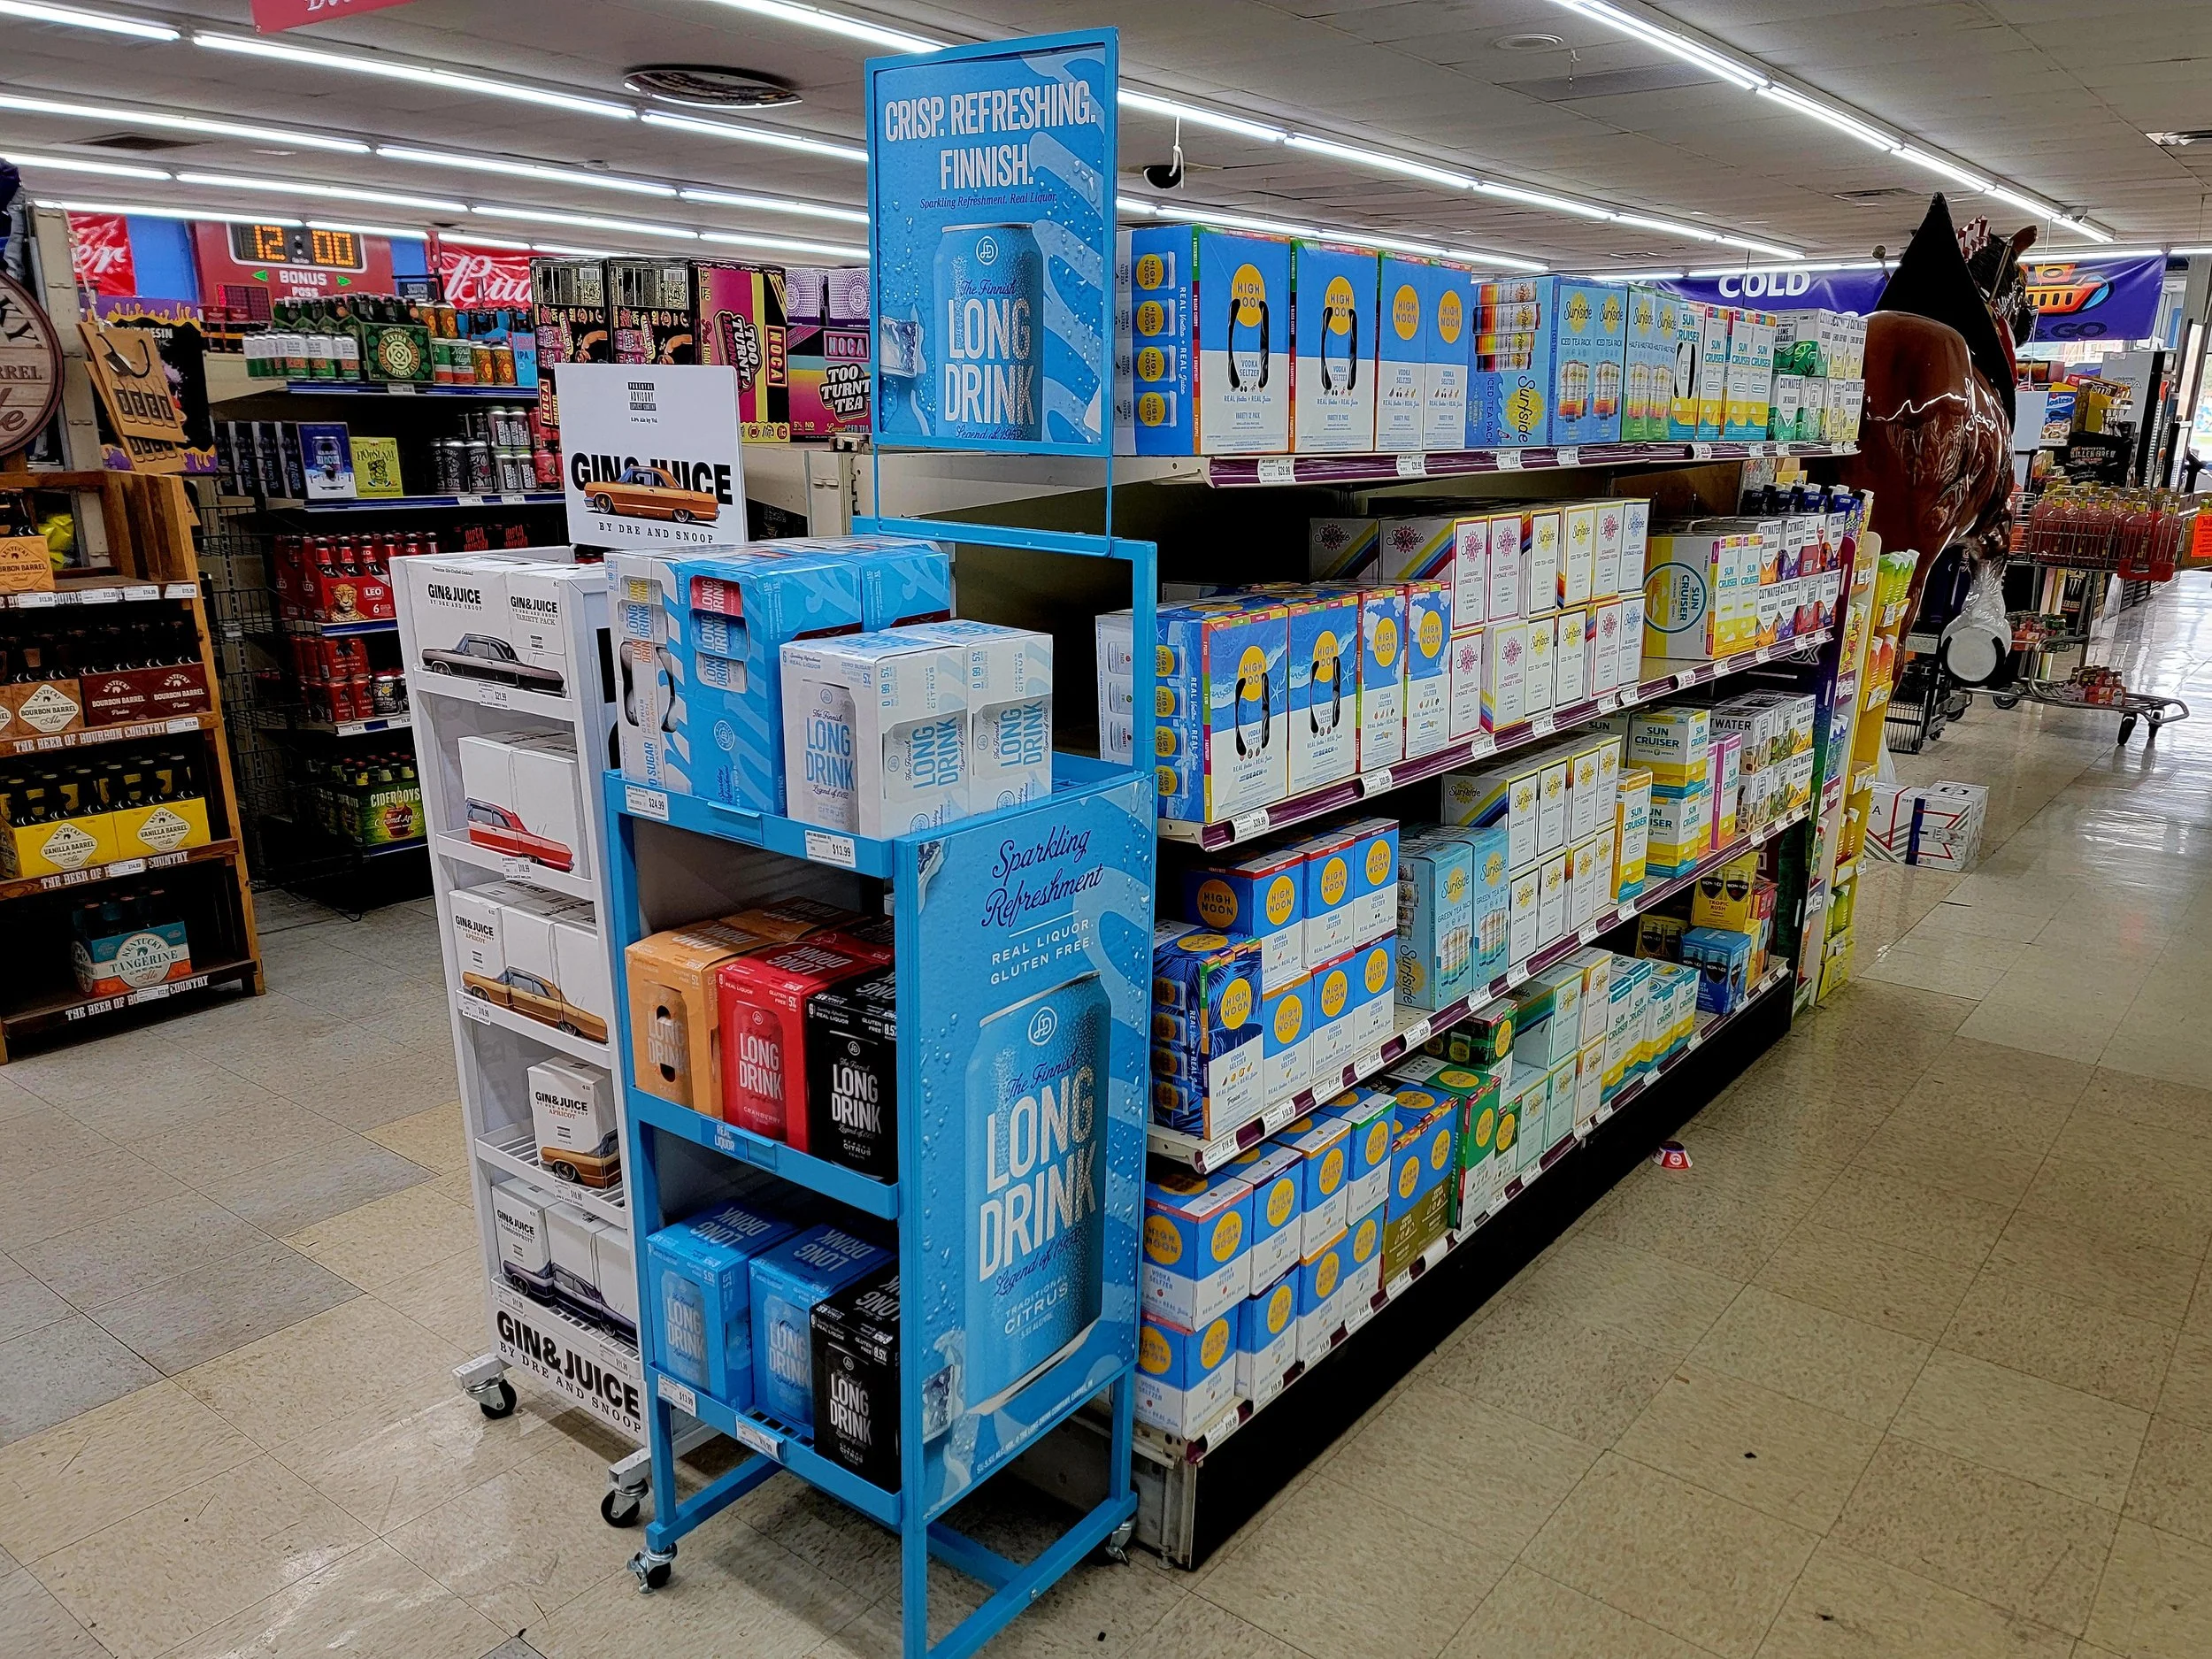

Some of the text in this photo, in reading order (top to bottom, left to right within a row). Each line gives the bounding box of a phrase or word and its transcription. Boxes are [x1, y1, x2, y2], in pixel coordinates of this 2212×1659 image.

[886, 81, 1096, 142] CRISP. REFRESHING.
[941, 143, 1033, 190] FINNISH.
[920, 193, 1057, 210] Sparkling Refreshment. Real Liquor.
[279, 271, 327, 286] BONUS
[961, 279, 1018, 296] The Finnish
[1237, 282, 1260, 295] HIGH
[1719, 271, 1810, 297] COLD
[1398, 301, 1416, 311] HIGH
[1563, 302, 1592, 322] Surfside
[948, 298, 1031, 360] LONG
[1395, 313, 1417, 324] NOON
[1682, 314, 1695, 326] SUN
[2051, 322, 2108, 338] GO
[733, 319, 751, 383] TURNT
[747, 328, 759, 365] TOO
[770, 331, 783, 380] NOCA
[828, 336, 866, 357] NOCA
[828, 365, 858, 380] TOO
[630, 391, 654, 402] ADVISORY
[835, 396, 863, 413] TEA
[944, 364, 1034, 425] DRINK
[1517, 375, 1535, 443] Surfside
[599, 522, 713, 543] BY DRE AND SNOOP
[364, 587, 383, 598] LEO
[428, 584, 481, 604] GIN&JUICE
[1680, 574, 1689, 621] CRUISER
[1690, 585, 1700, 610] SUN
[511, 595, 557, 613] GIN&JUICE
[1376, 642, 1396, 653] NOON
[1377, 634, 1394, 643] HIGH
[92, 695, 145, 707] BOURBON BARREL
[38, 738, 63, 749] BEER
[65, 735, 76, 746] OF
[81, 728, 122, 743] BOURBON
[806, 718, 851, 757] LONG
[1646, 726, 1669, 736] SUN
[936, 717, 958, 787] DRINK
[1634, 735, 1679, 749] CRUISER
[911, 725, 936, 789] LONG
[805, 750, 854, 791] DRINK
[370, 787, 420, 808] CIDERBOYS
[649, 795, 664, 810] $24.99
[140, 829, 165, 838] VANILLA
[44, 841, 95, 855] VANILLA BARREL
[832, 843, 850, 857] $13.99
[993, 826, 1091, 885] Sparkling
[1440, 871, 1470, 898] Surfside
[982, 864, 1103, 927] Refreshment
[1203, 894, 1232, 904] HIGH
[1201, 902, 1234, 915] NOON
[456, 916, 494, 936] GIN&JUICE
[122, 937, 162, 956] KENTUCKY
[992, 920, 1094, 965] REAL LIQUOR.
[110, 951, 177, 973] TANGERINE
[990, 937, 1094, 985] GLUTEN FREE.
[88, 1002, 111, 1015] BEER
[740, 1032, 780, 1071] LONG
[1031, 1048, 1079, 1089] Finnish
[739, 1059, 783, 1101] DRINK
[833, 1064, 878, 1102] LONG
[535, 1091, 588, 1112] GIN&JUICE
[549, 1109, 576, 1119] APRICOT
[832, 1093, 882, 1133] DRINK
[717, 1124, 732, 1139] REAL
[987, 1066, 1094, 1194] LONG
[714, 1136, 734, 1152] LIQUOR
[497, 1210, 534, 1235] GIN&JUICE
[979, 1142, 1096, 1283] DRINK
[995, 1257, 1039, 1297] Legend
[1039, 1245, 1054, 1272] of
[666, 1299, 701, 1329] LONG
[1005, 1283, 1068, 1334] CITRUS
[667, 1322, 704, 1361] DRINK
[496, 1310, 641, 1421] GIN&JUICE
[499, 1340, 641, 1432] BY DRE AND SNOOP
[830, 1372, 869, 1416] LONG
[829, 1399, 872, 1446] DRINK
